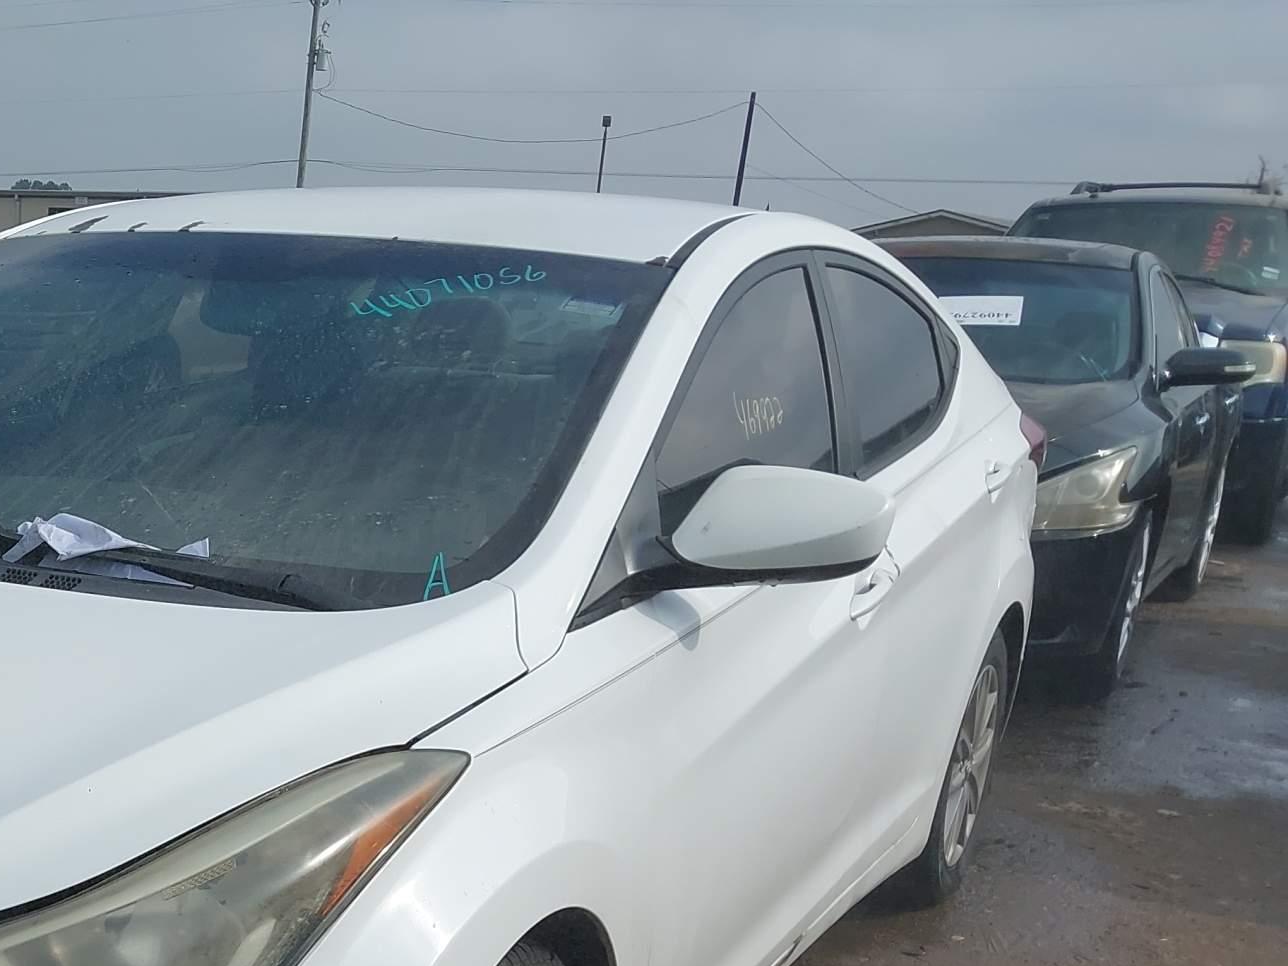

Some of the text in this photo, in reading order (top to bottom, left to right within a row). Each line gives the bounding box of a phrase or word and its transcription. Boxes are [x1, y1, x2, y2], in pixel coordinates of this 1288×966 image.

[350, 264, 547, 318] 44071056
[950, 311, 1015, 319] 4409279
[423, 551, 451, 601] A
